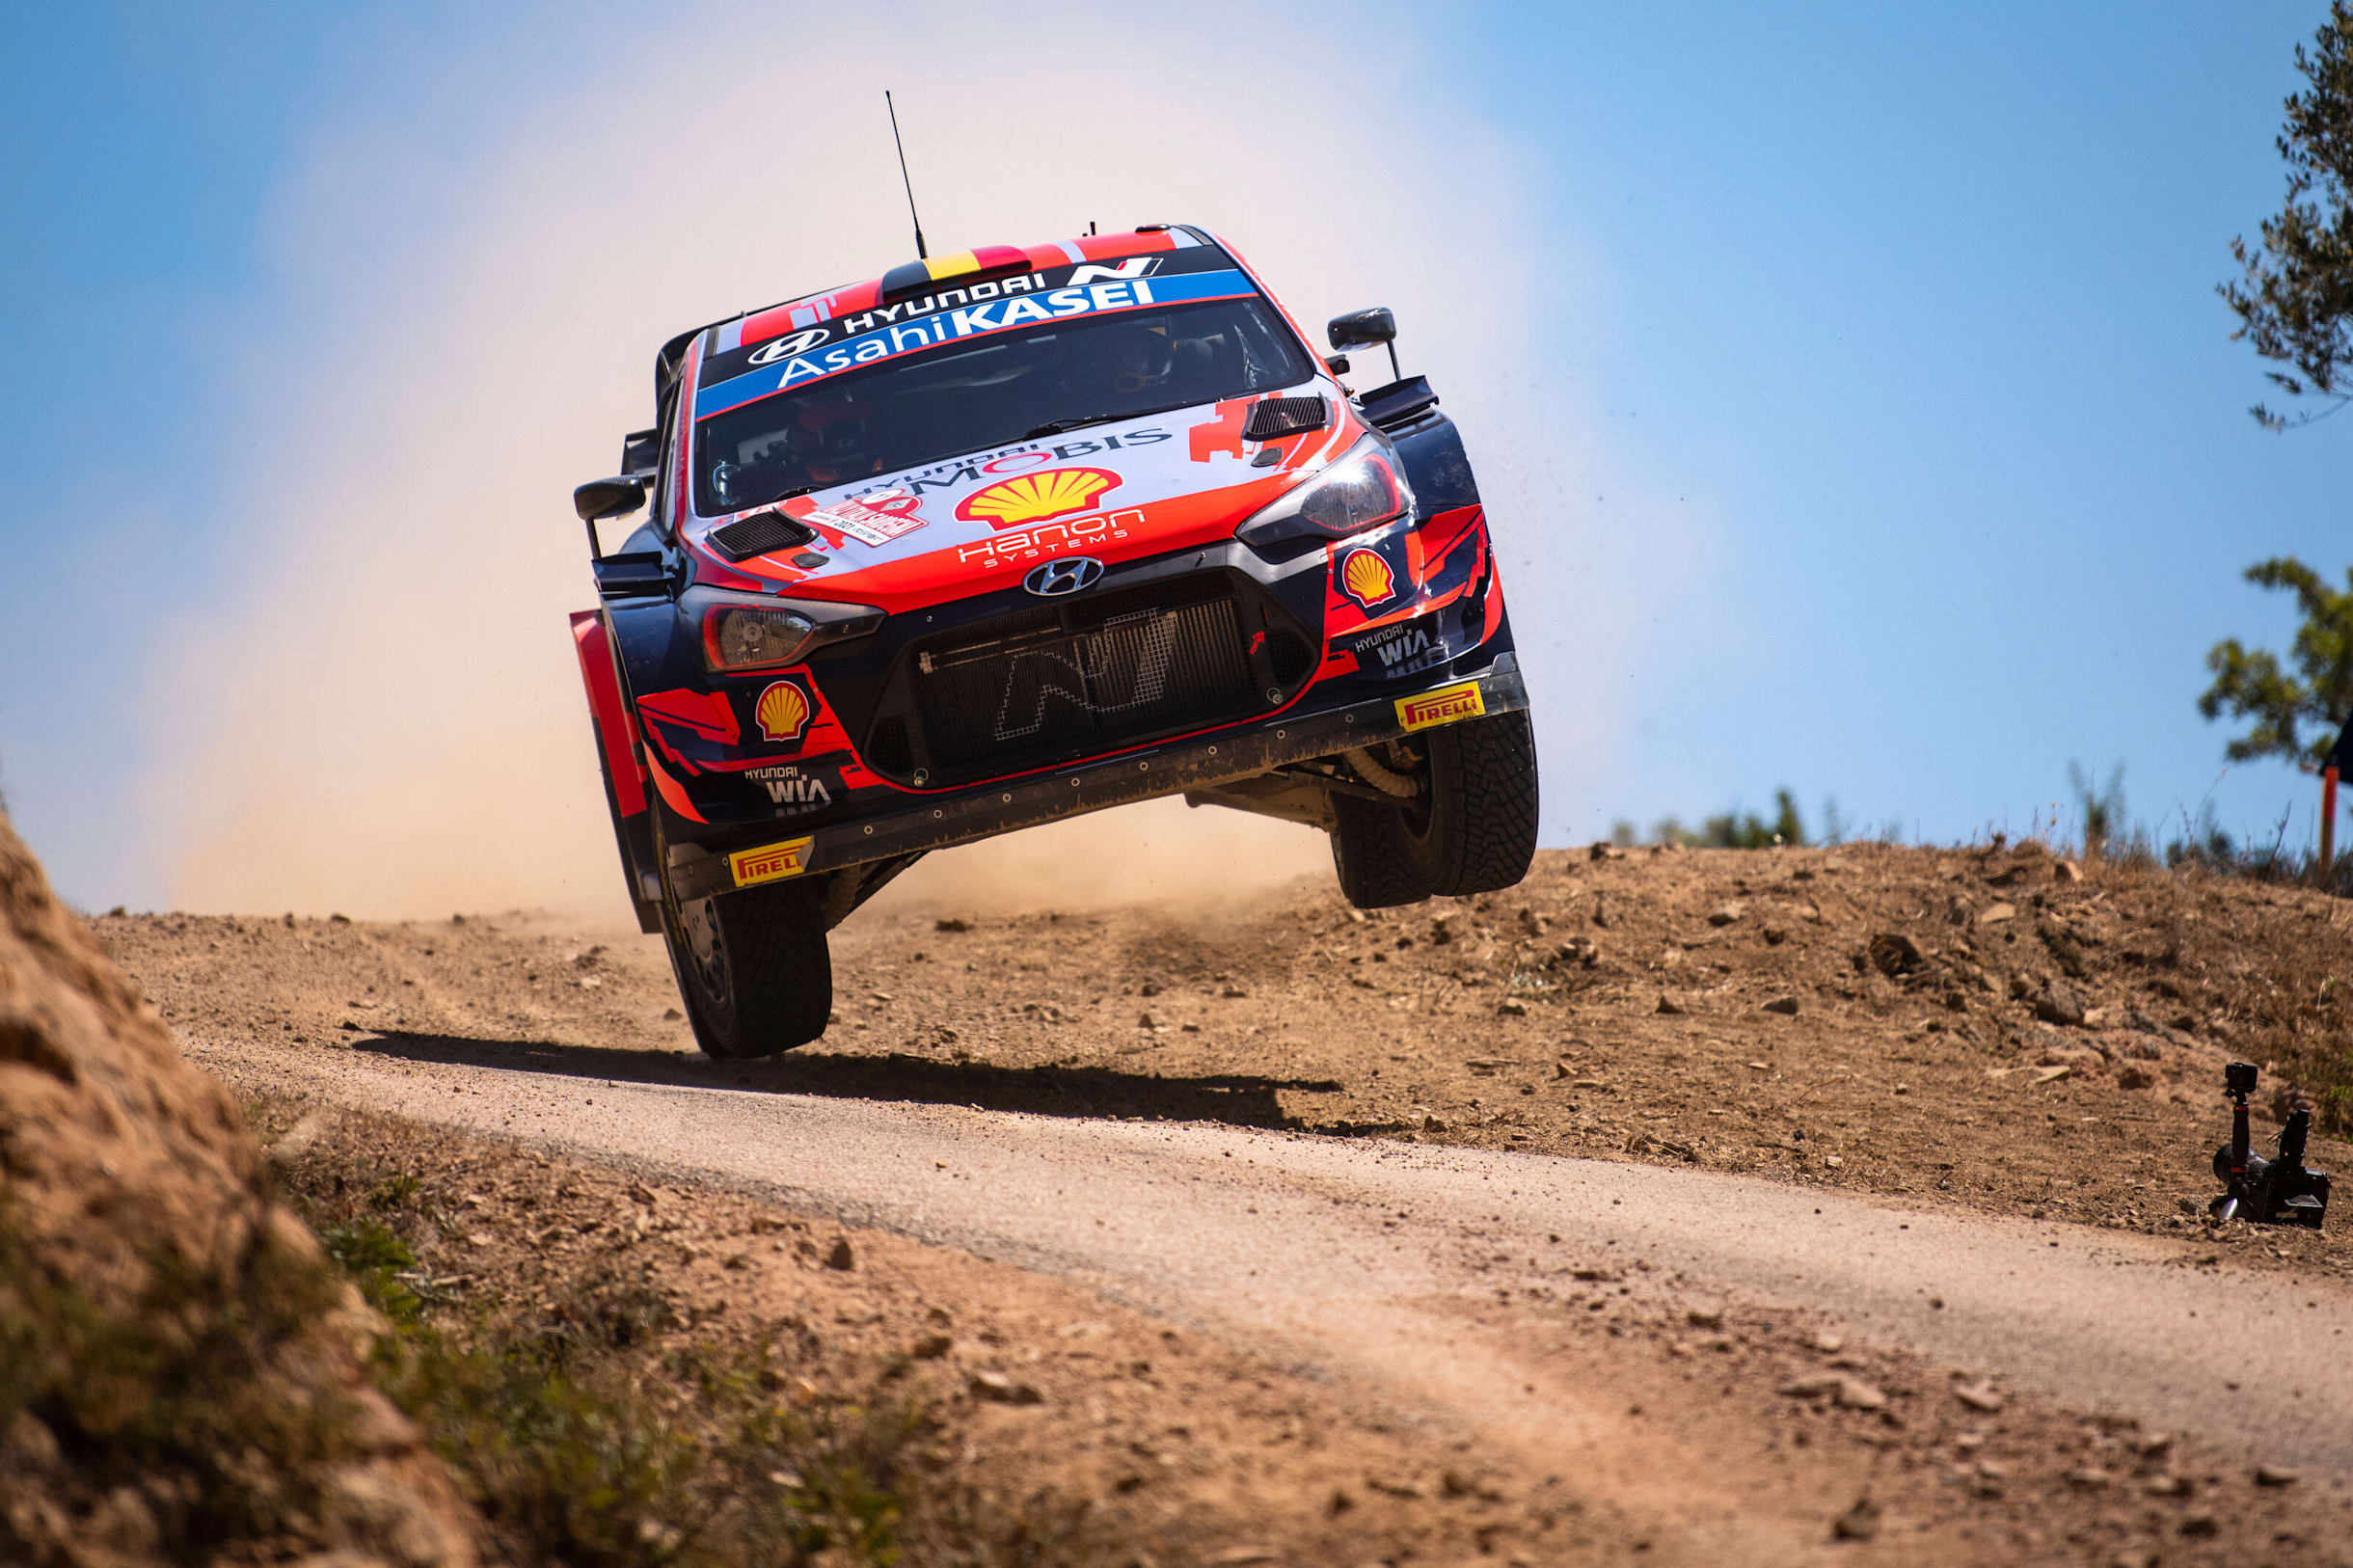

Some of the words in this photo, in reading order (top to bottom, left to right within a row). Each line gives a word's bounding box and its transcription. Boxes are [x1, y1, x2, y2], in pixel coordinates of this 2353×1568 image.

[844, 273, 1046, 335] HYUNDAI
[843, 443, 1040, 500] HYUNDAI
[903, 427, 1174, 496] MOBIS
[984, 529, 1128, 568] SYSTEMS
[1355, 624, 1404, 653] HYUNDAI
[1405, 689, 1477, 725] PIRELLI
[744, 767, 798, 780] HYUNDAI
[737, 845, 804, 879] PIREL
